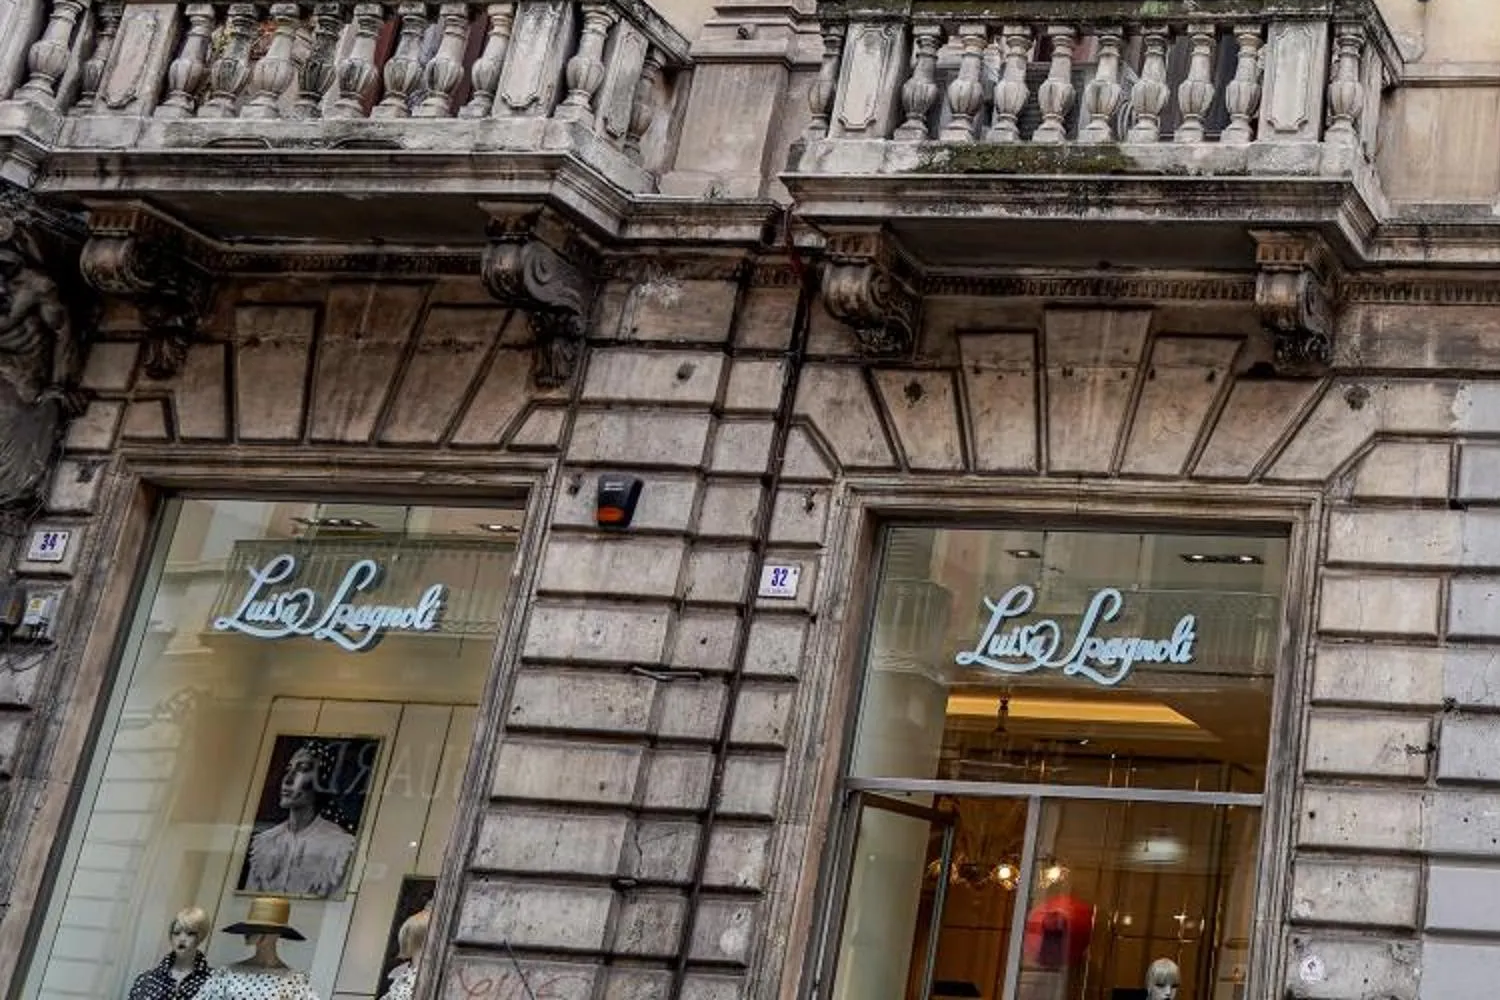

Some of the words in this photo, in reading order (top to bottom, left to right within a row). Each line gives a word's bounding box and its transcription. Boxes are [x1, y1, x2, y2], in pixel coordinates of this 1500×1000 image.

[41, 533, 58, 550] 34
[214, 554, 314, 637] Luisa
[308, 560, 443, 651] Spagnoli
[771, 567, 789, 587] 32
[956, 585, 1060, 673] Luisa
[1054, 588, 1195, 685] Spagnoli
